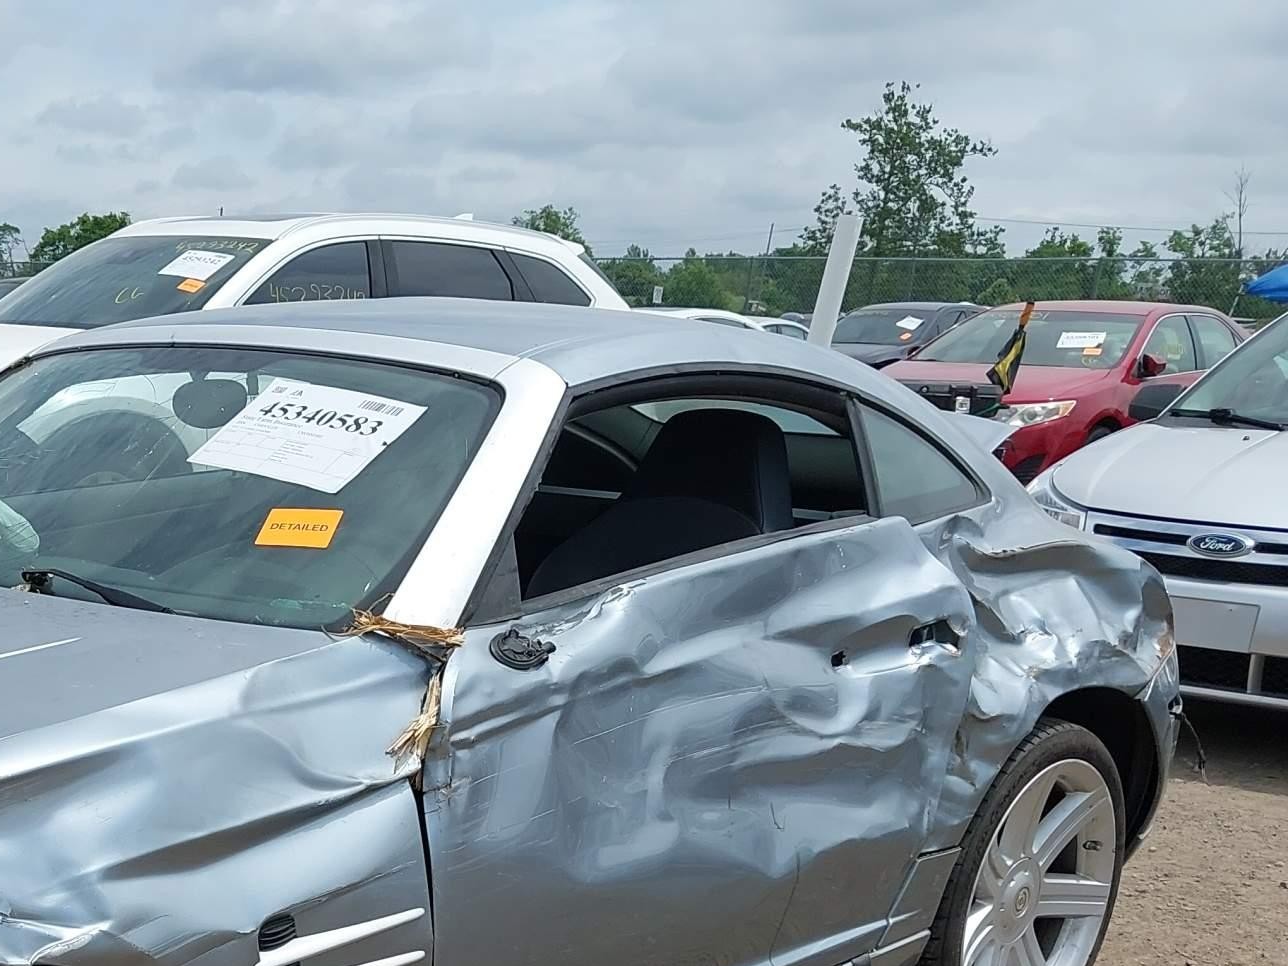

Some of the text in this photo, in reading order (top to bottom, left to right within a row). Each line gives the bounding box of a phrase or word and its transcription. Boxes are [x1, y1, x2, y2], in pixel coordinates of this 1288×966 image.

[260, 401, 384, 436] 45340583
[270, 523, 328, 532] DETAILED
[1200, 536, 1235, 551] Ford
